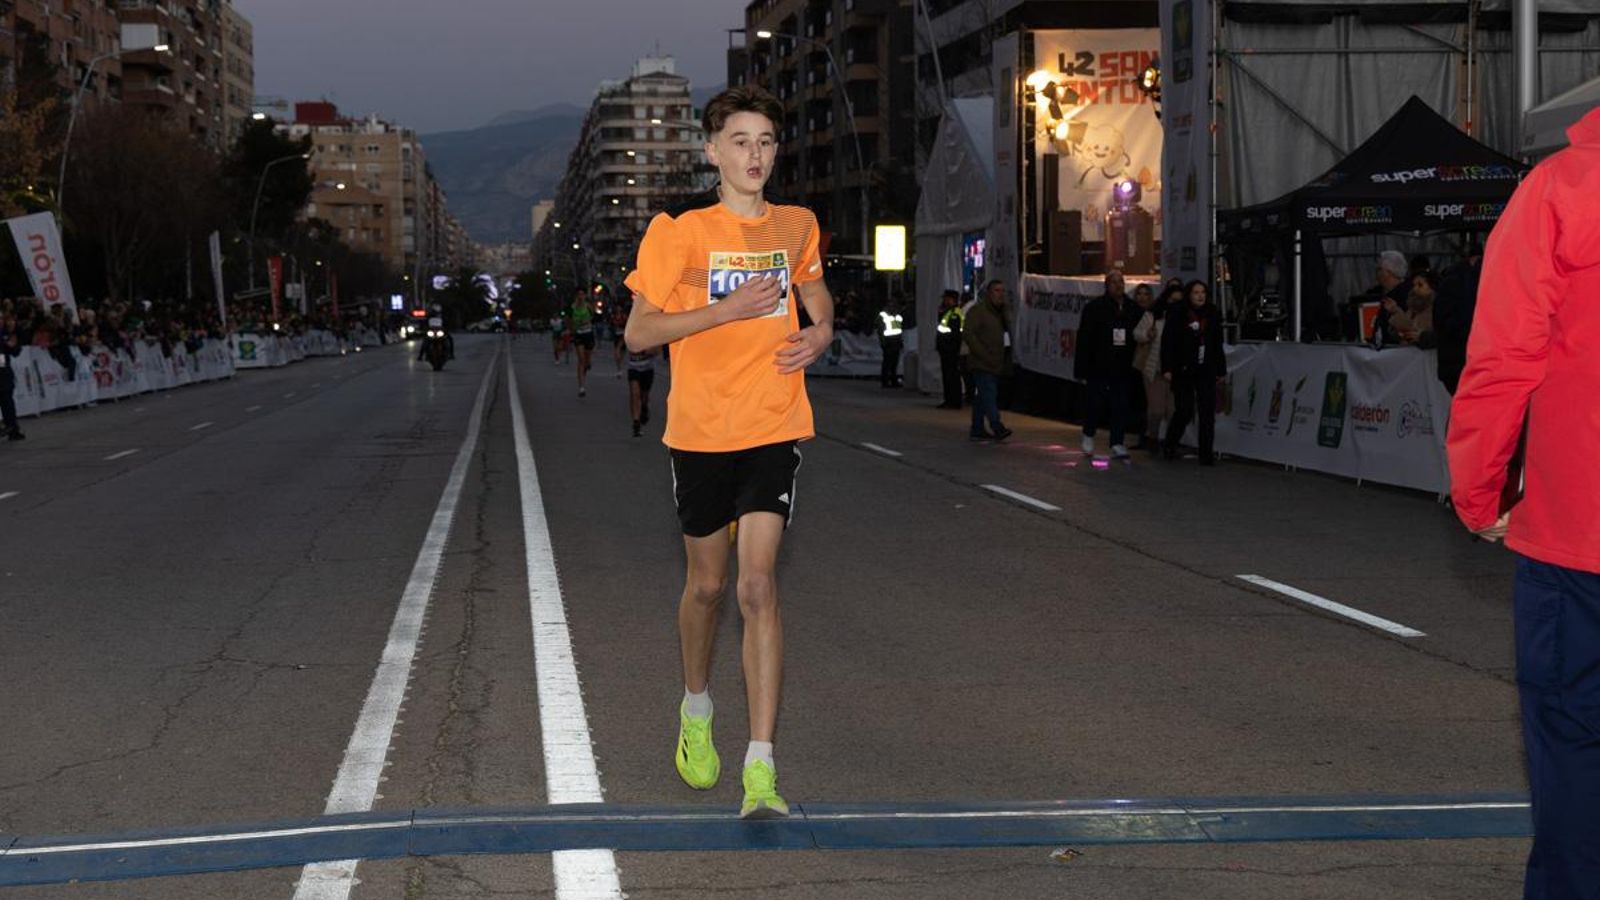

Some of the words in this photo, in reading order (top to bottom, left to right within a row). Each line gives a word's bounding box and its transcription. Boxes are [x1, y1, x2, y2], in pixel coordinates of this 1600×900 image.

[1058, 50, 1095, 77] 42
[1306, 204, 1393, 222] superscreen
[728, 256, 745, 268] 42
